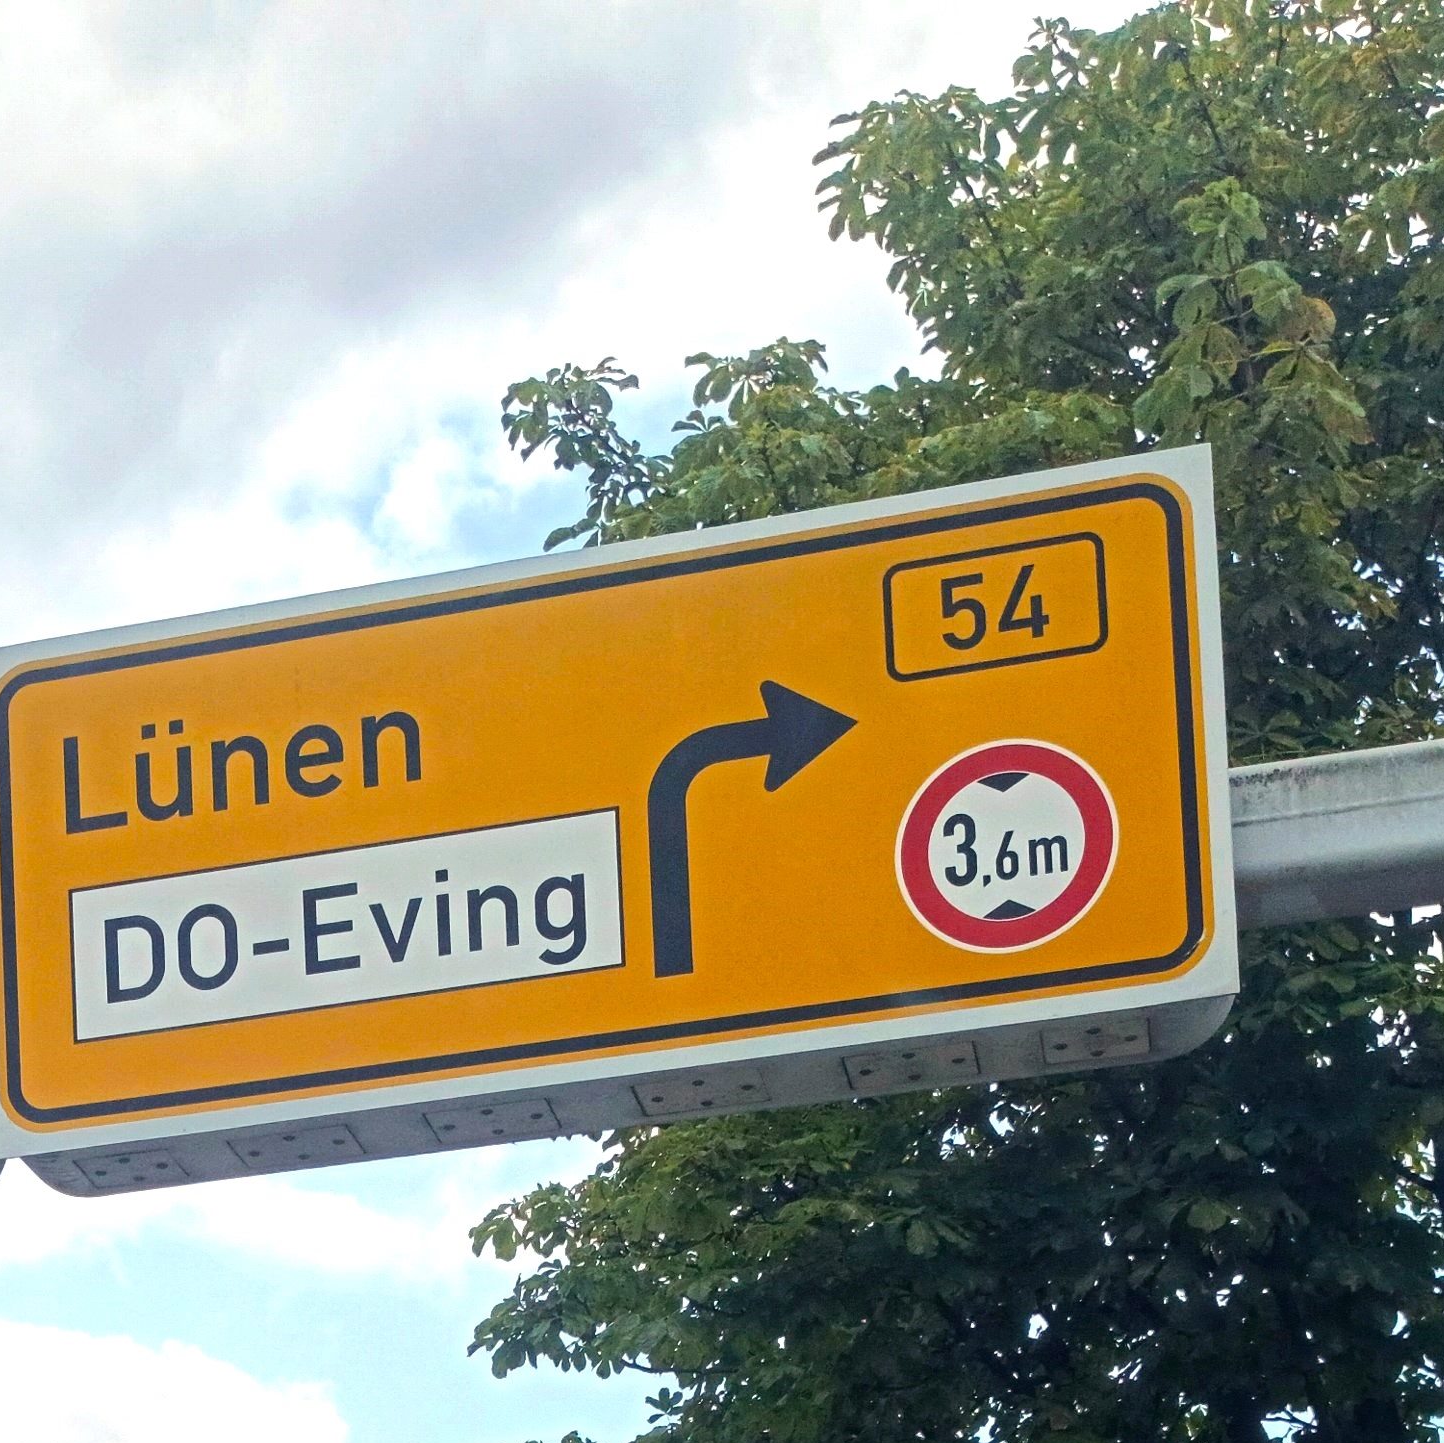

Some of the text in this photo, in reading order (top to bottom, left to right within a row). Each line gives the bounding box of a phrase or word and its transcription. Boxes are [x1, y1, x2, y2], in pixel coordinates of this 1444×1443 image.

[939, 562, 1050, 651] 54
[63, 709, 422, 835] Lünen
[942, 812, 1070, 888] 3,6m
[104, 868, 588, 1006] DO-Eving
